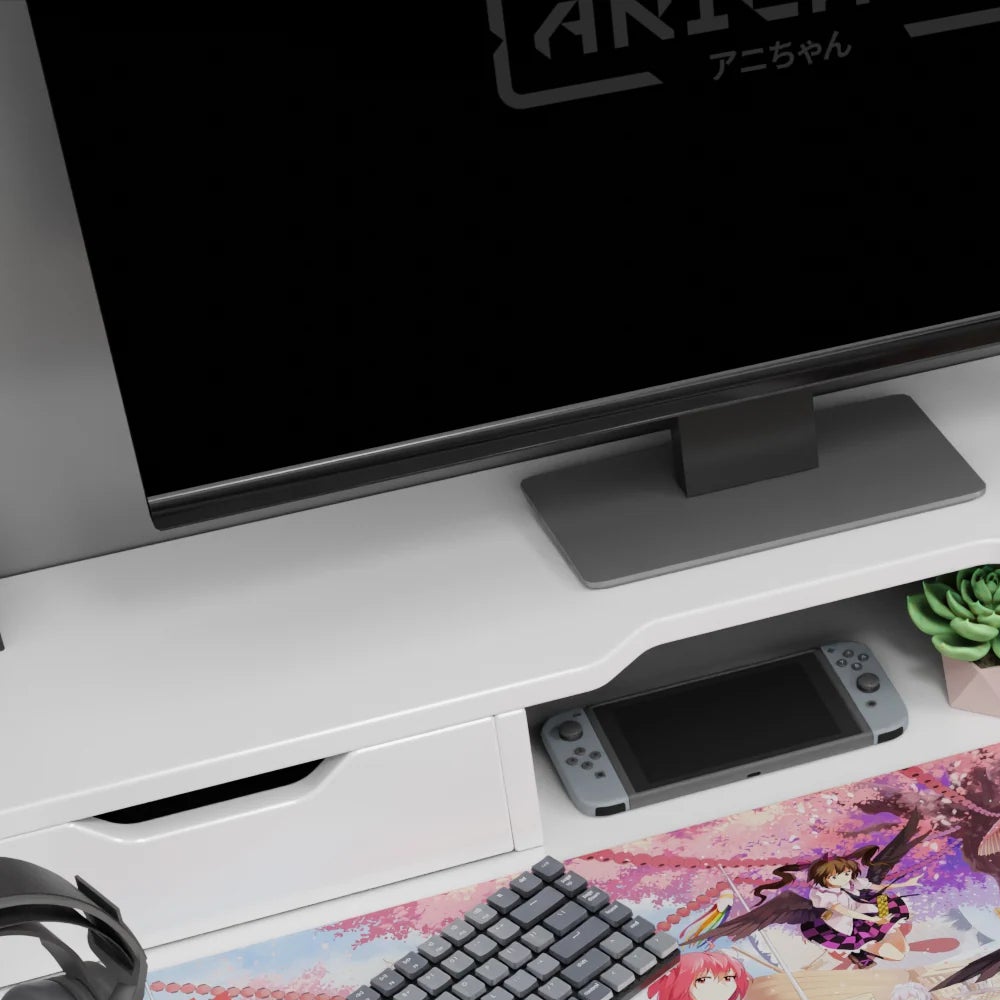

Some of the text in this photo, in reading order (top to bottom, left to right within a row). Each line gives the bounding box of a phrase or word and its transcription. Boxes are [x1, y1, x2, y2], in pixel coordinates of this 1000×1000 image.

[708, 31, 852, 80] アニちゃん
